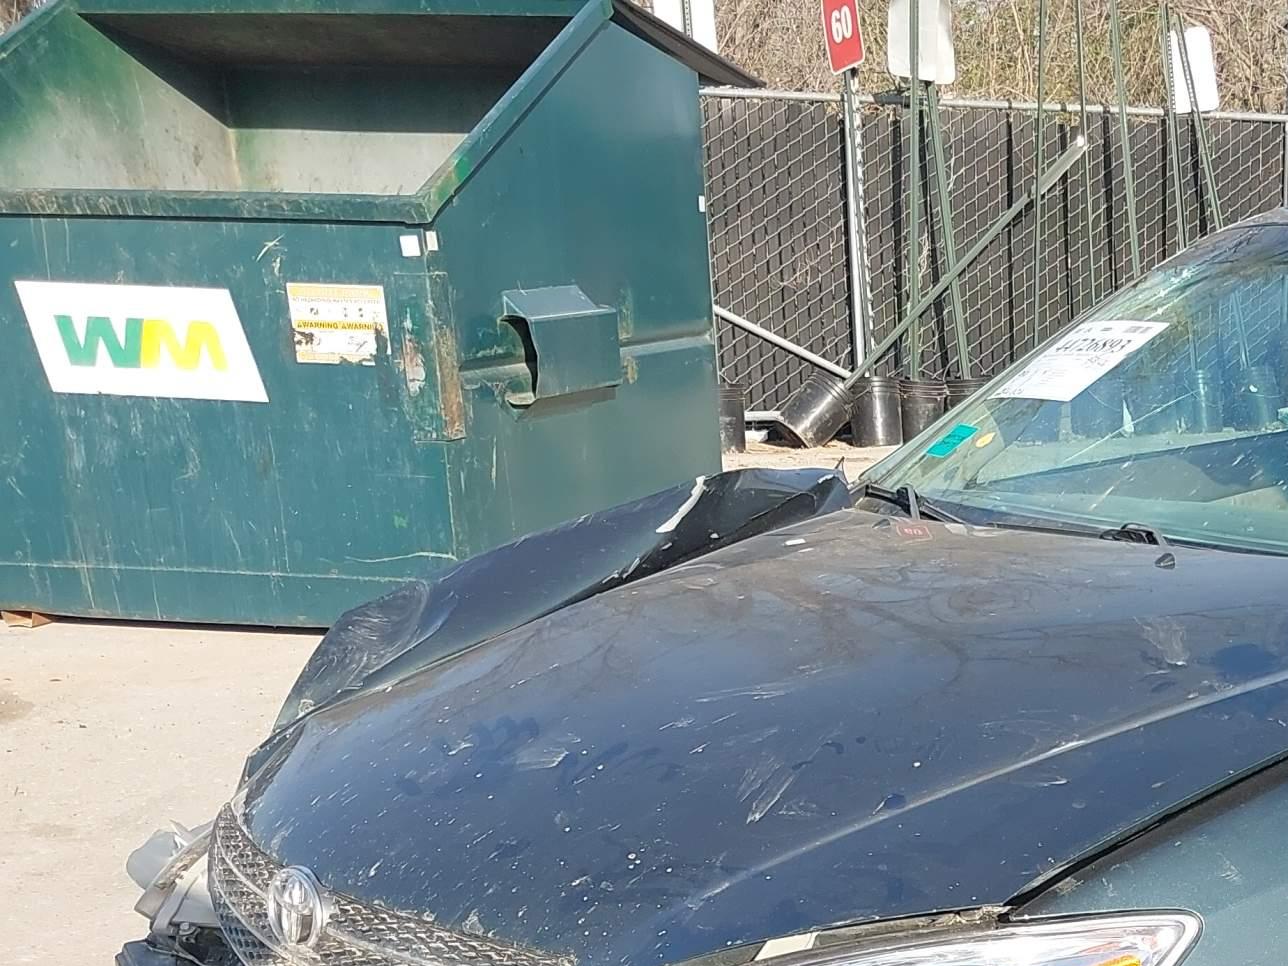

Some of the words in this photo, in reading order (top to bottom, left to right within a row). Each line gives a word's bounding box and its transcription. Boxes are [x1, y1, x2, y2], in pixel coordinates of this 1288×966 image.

[831, 5, 853, 44] 60
[302, 321, 338, 329] WARNING
[53, 314, 229, 372] WM
[1055, 337, 1132, 353] 44726893
